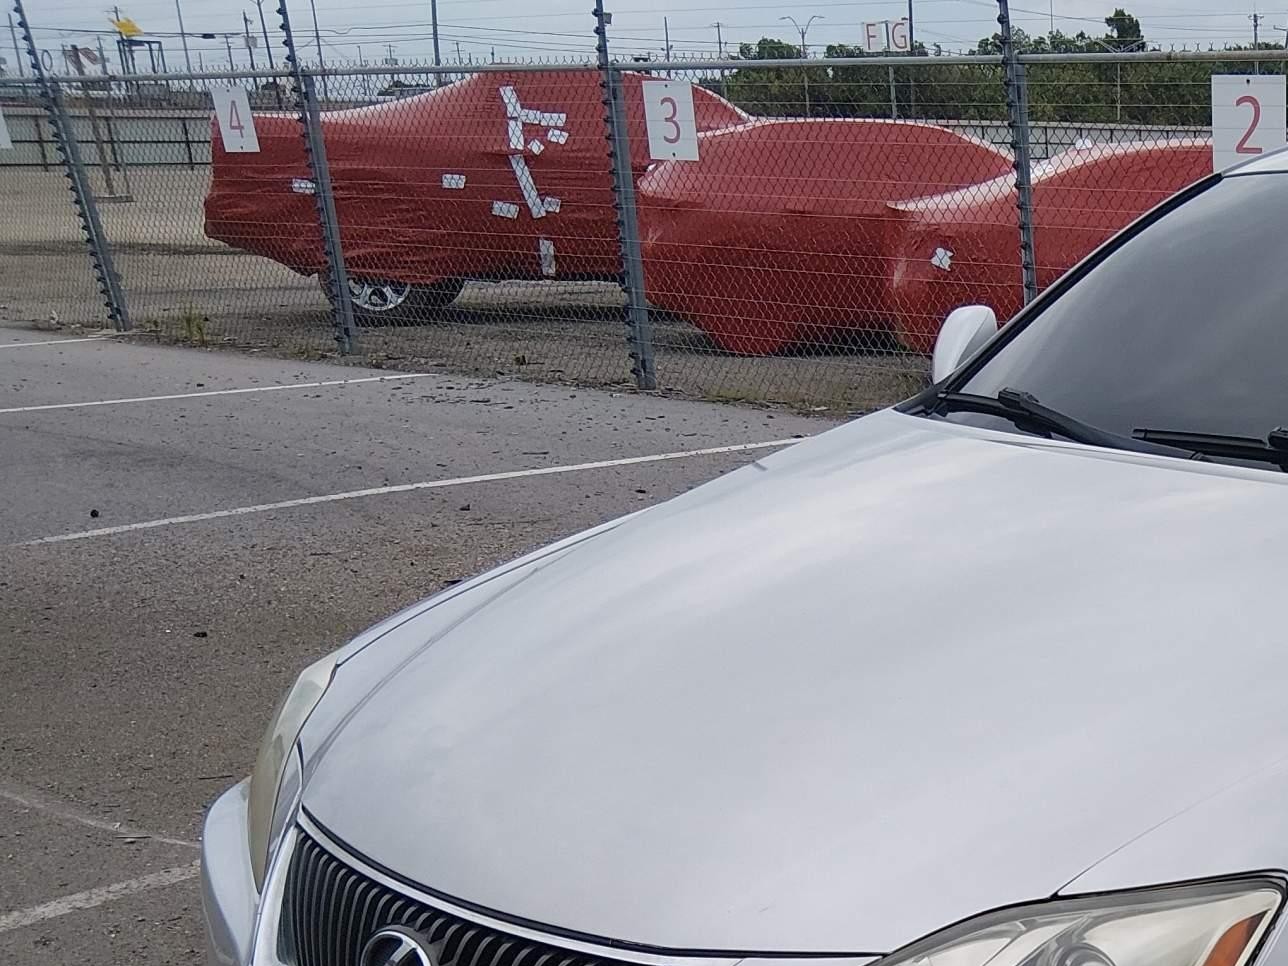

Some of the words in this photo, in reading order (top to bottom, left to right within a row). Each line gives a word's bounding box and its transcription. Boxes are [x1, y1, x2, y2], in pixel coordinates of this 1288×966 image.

[866, 23, 877, 50] F
[891, 22, 907, 49] G
[229, 100, 245, 138] 4
[660, 96, 681, 144] 3
[1235, 95, 1263, 154] 2
